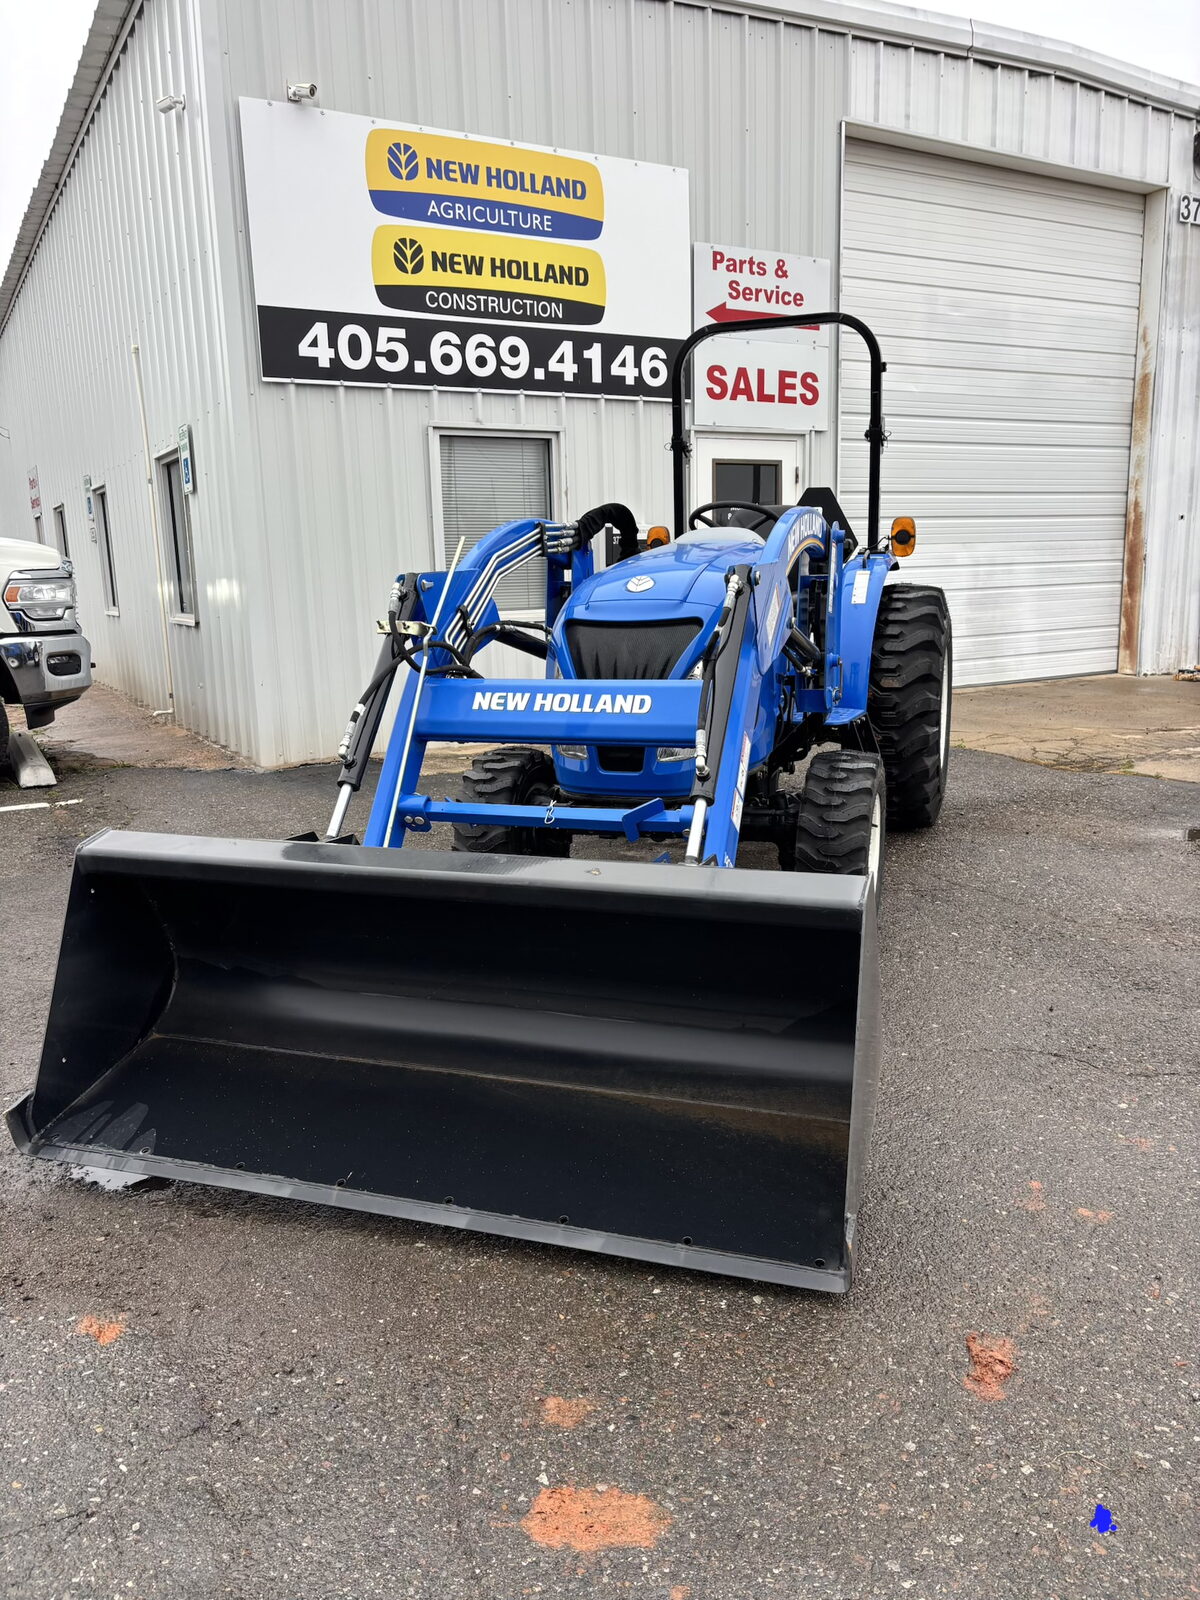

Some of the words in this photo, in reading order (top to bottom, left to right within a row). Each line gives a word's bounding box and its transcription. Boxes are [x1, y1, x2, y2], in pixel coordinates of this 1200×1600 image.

[426, 157, 479, 185] NEW
[486, 167, 587, 201] HOLLAND
[427, 200, 553, 231] AGRICULTURE
[431, 251, 484, 277] NEW
[490, 257, 590, 287] HOLLAND
[712, 250, 767, 277] Parts
[774, 258, 789, 279] &
[425, 290, 564, 319] CONSTRUCTION
[728, 280, 804, 307] Service
[298, 322, 668, 387] 405.669.4146
[706, 364, 819, 406] SALES
[472, 691, 531, 711] NEW
[533, 693, 652, 714] HOLLAND
